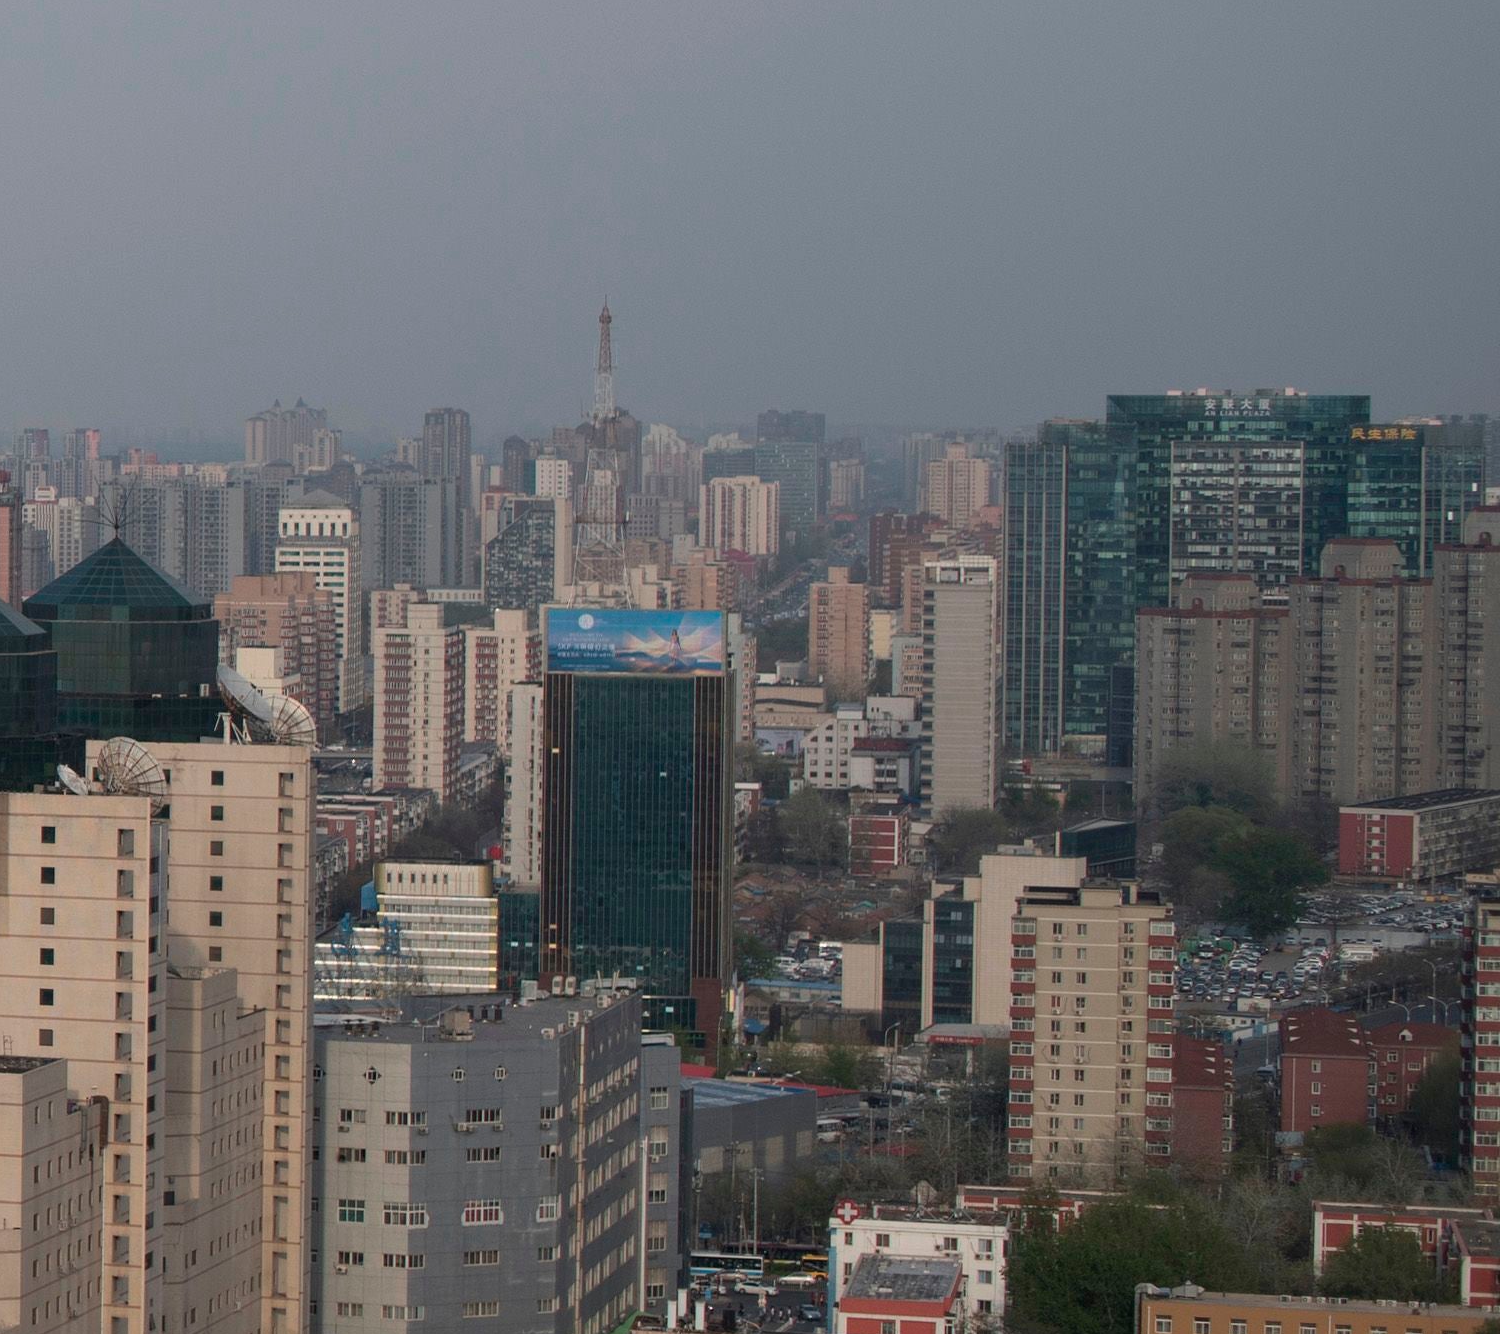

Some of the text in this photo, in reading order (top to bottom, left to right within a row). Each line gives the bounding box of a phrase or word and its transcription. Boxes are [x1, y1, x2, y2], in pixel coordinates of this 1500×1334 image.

[1204, 398, 1271, 410] 安联大厦
[1351, 428, 1418, 441] 民生保险
